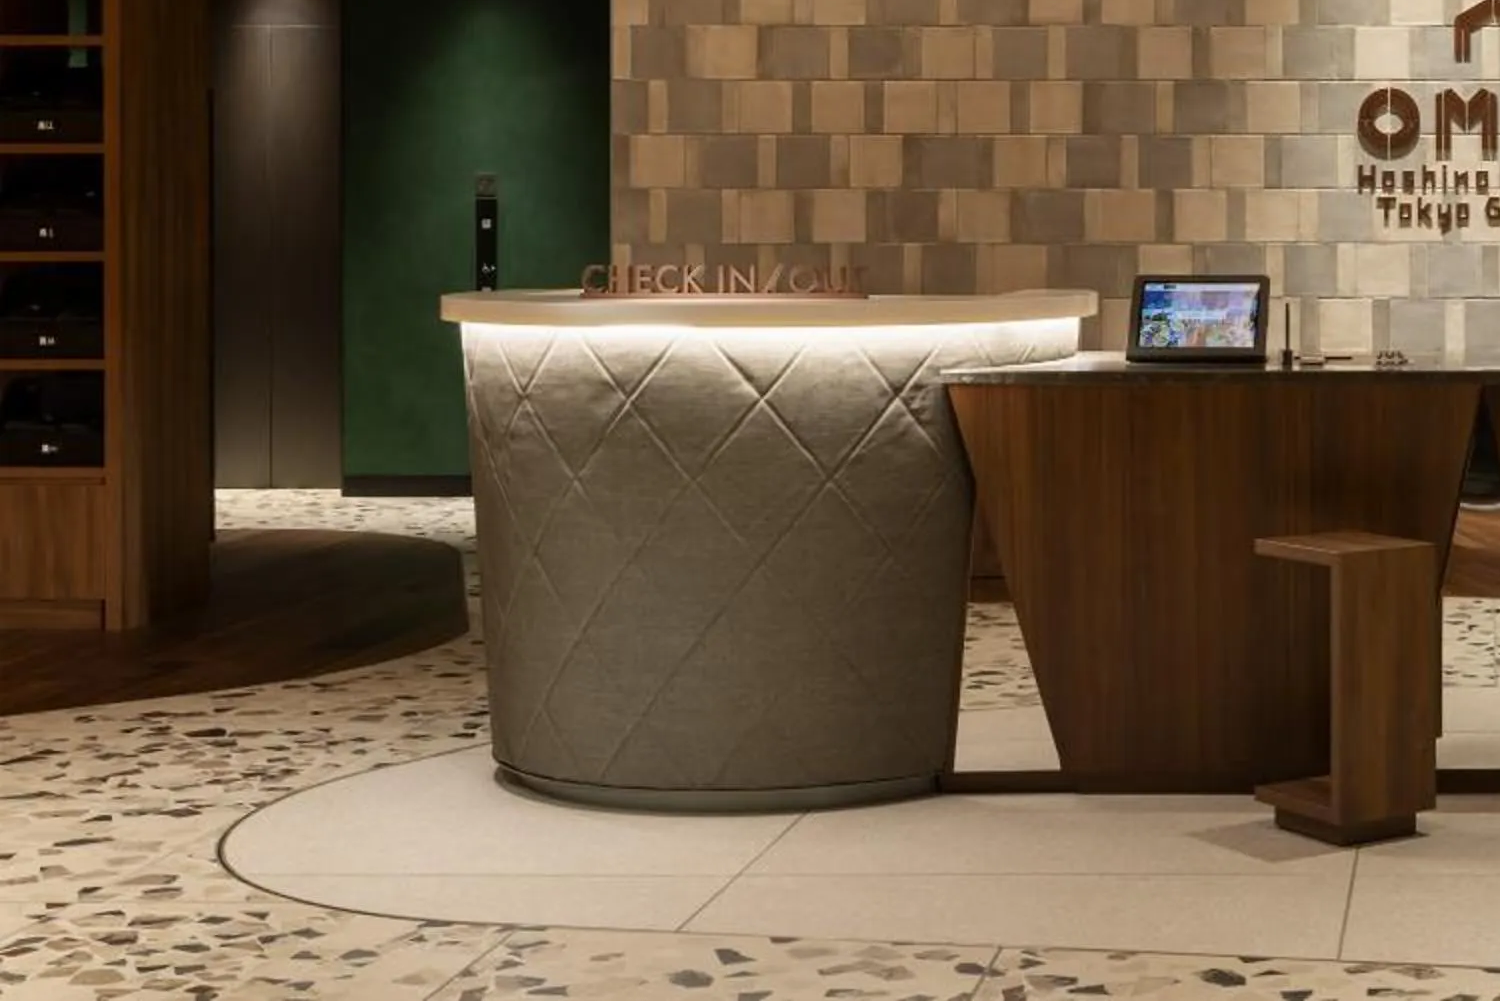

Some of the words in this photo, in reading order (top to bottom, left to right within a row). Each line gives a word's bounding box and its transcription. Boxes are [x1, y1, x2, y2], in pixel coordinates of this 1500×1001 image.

[1357, 165, 1490, 195] Hoshino
[1376, 197, 1470, 234] Tokyo
[581, 265, 704, 293] CHECK
